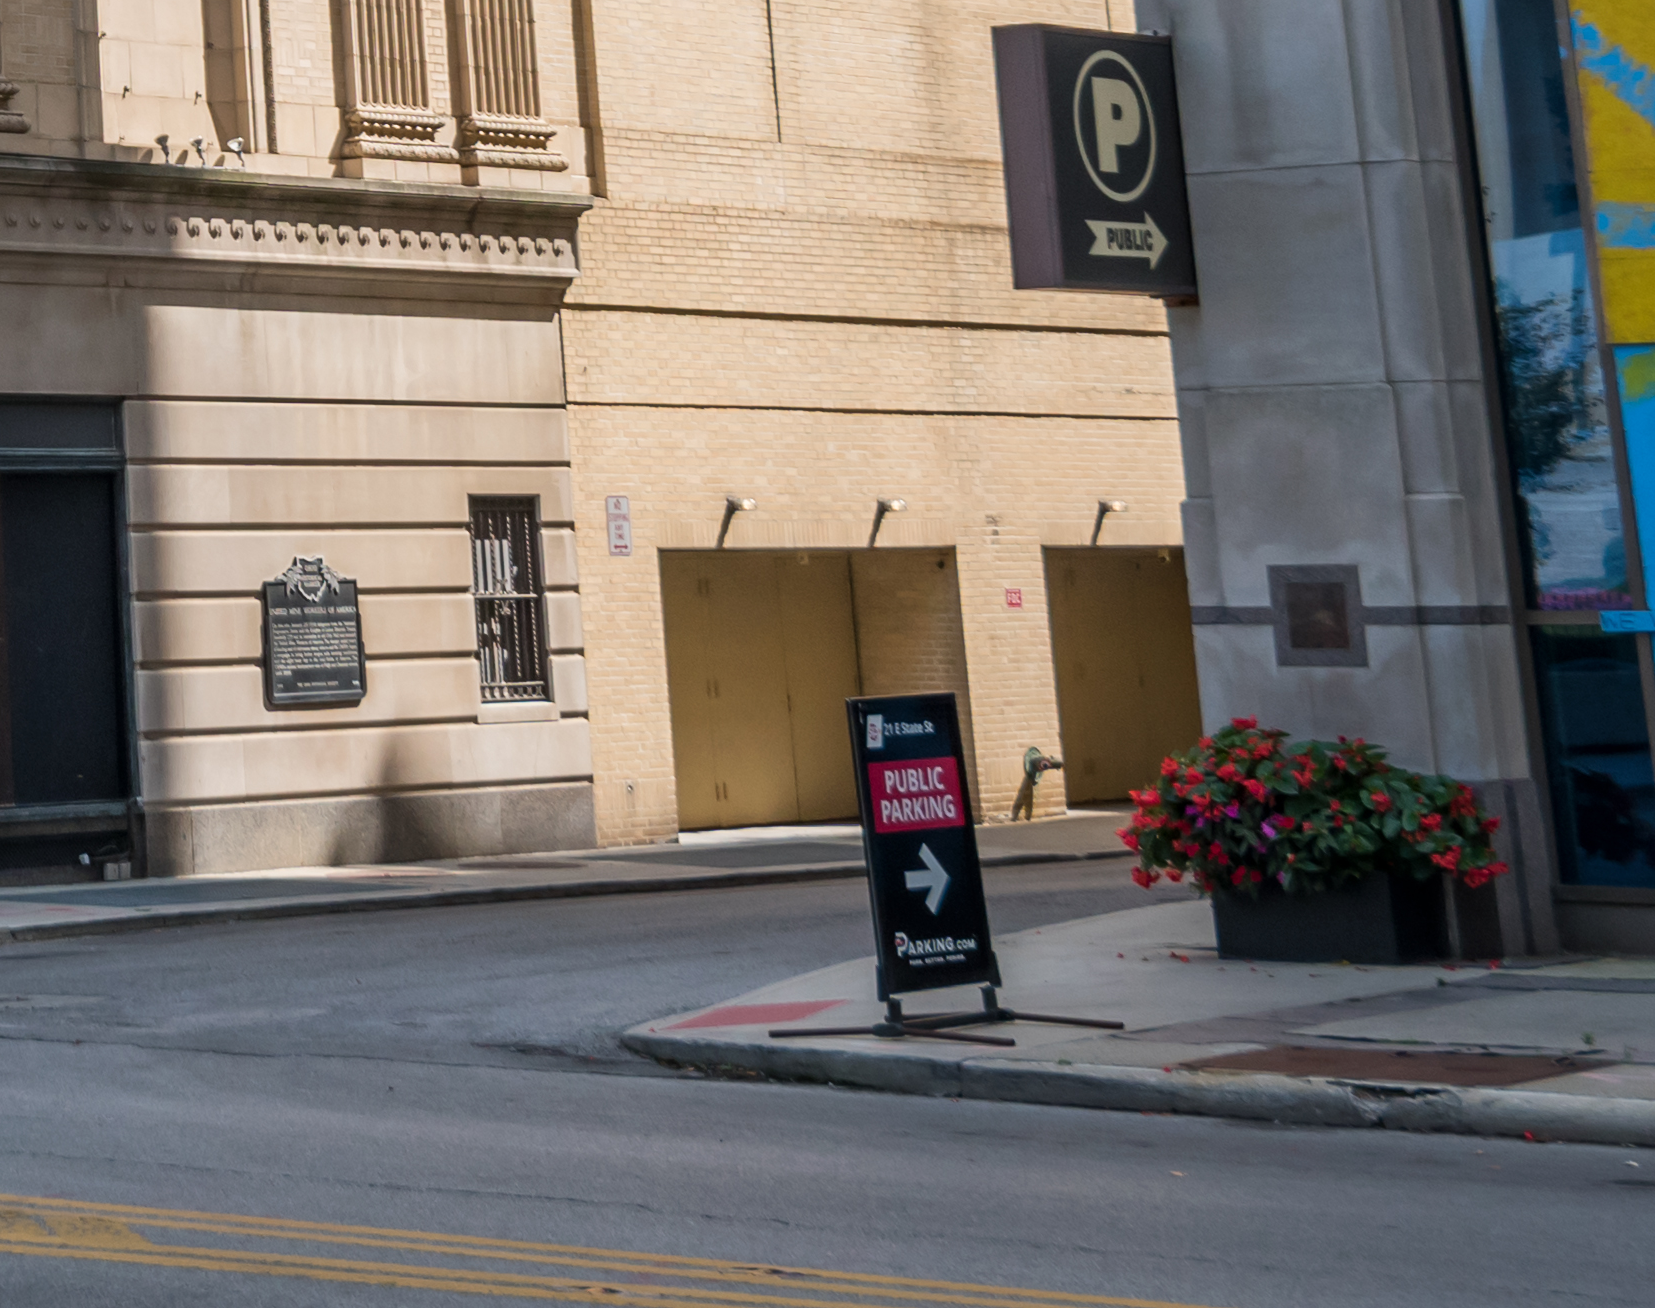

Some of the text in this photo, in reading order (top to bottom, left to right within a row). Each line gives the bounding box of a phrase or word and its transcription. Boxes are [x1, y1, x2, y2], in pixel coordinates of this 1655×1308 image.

[1091, 76, 1140, 173] P
[1106, 227, 1154, 251] PUBLIC
[884, 723, 893, 736] 21
[895, 723, 901, 735] E
[901, 722, 923, 735] State
[923, 720, 935, 733] St
[883, 766, 945, 794] PUBLIC
[880, 794, 956, 824] PARKING
